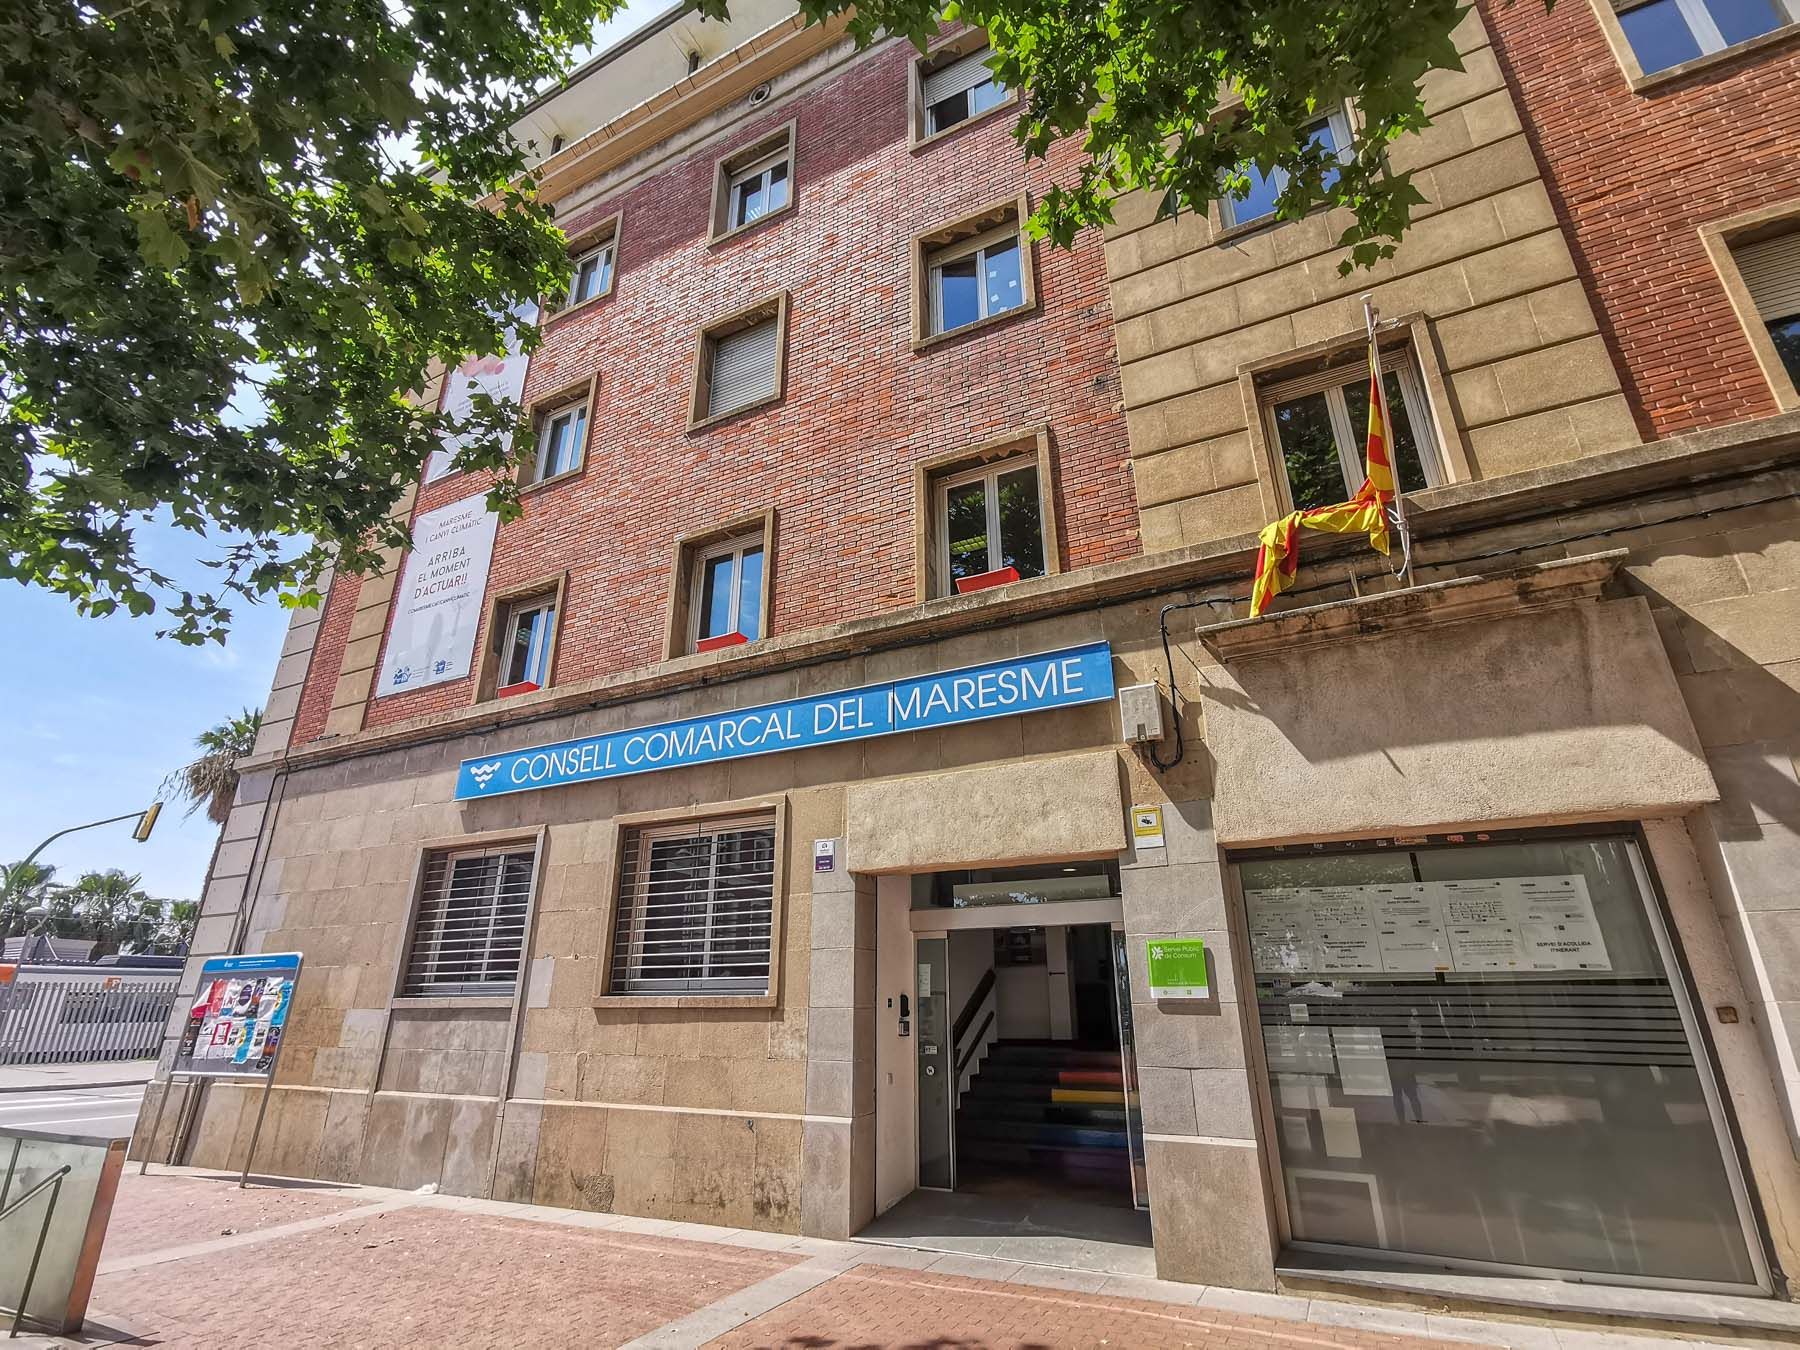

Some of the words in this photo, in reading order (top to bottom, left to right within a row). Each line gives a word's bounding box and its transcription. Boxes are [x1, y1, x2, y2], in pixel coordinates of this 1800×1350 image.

[439, 510, 473, 530] MARESME
[429, 529, 450, 542] CANVI
[427, 546, 466, 567] ARRIBA
[417, 573, 427, 583] EL
[430, 558, 471, 580] MOMENT
[414, 572, 468, 600] D'ACTUAR!!
[510, 742, 617, 784] CONSELL
[623, 709, 801, 765] COMARCAL
[813, 697, 873, 735] DEL
[887, 658, 1083, 724] MARESME
